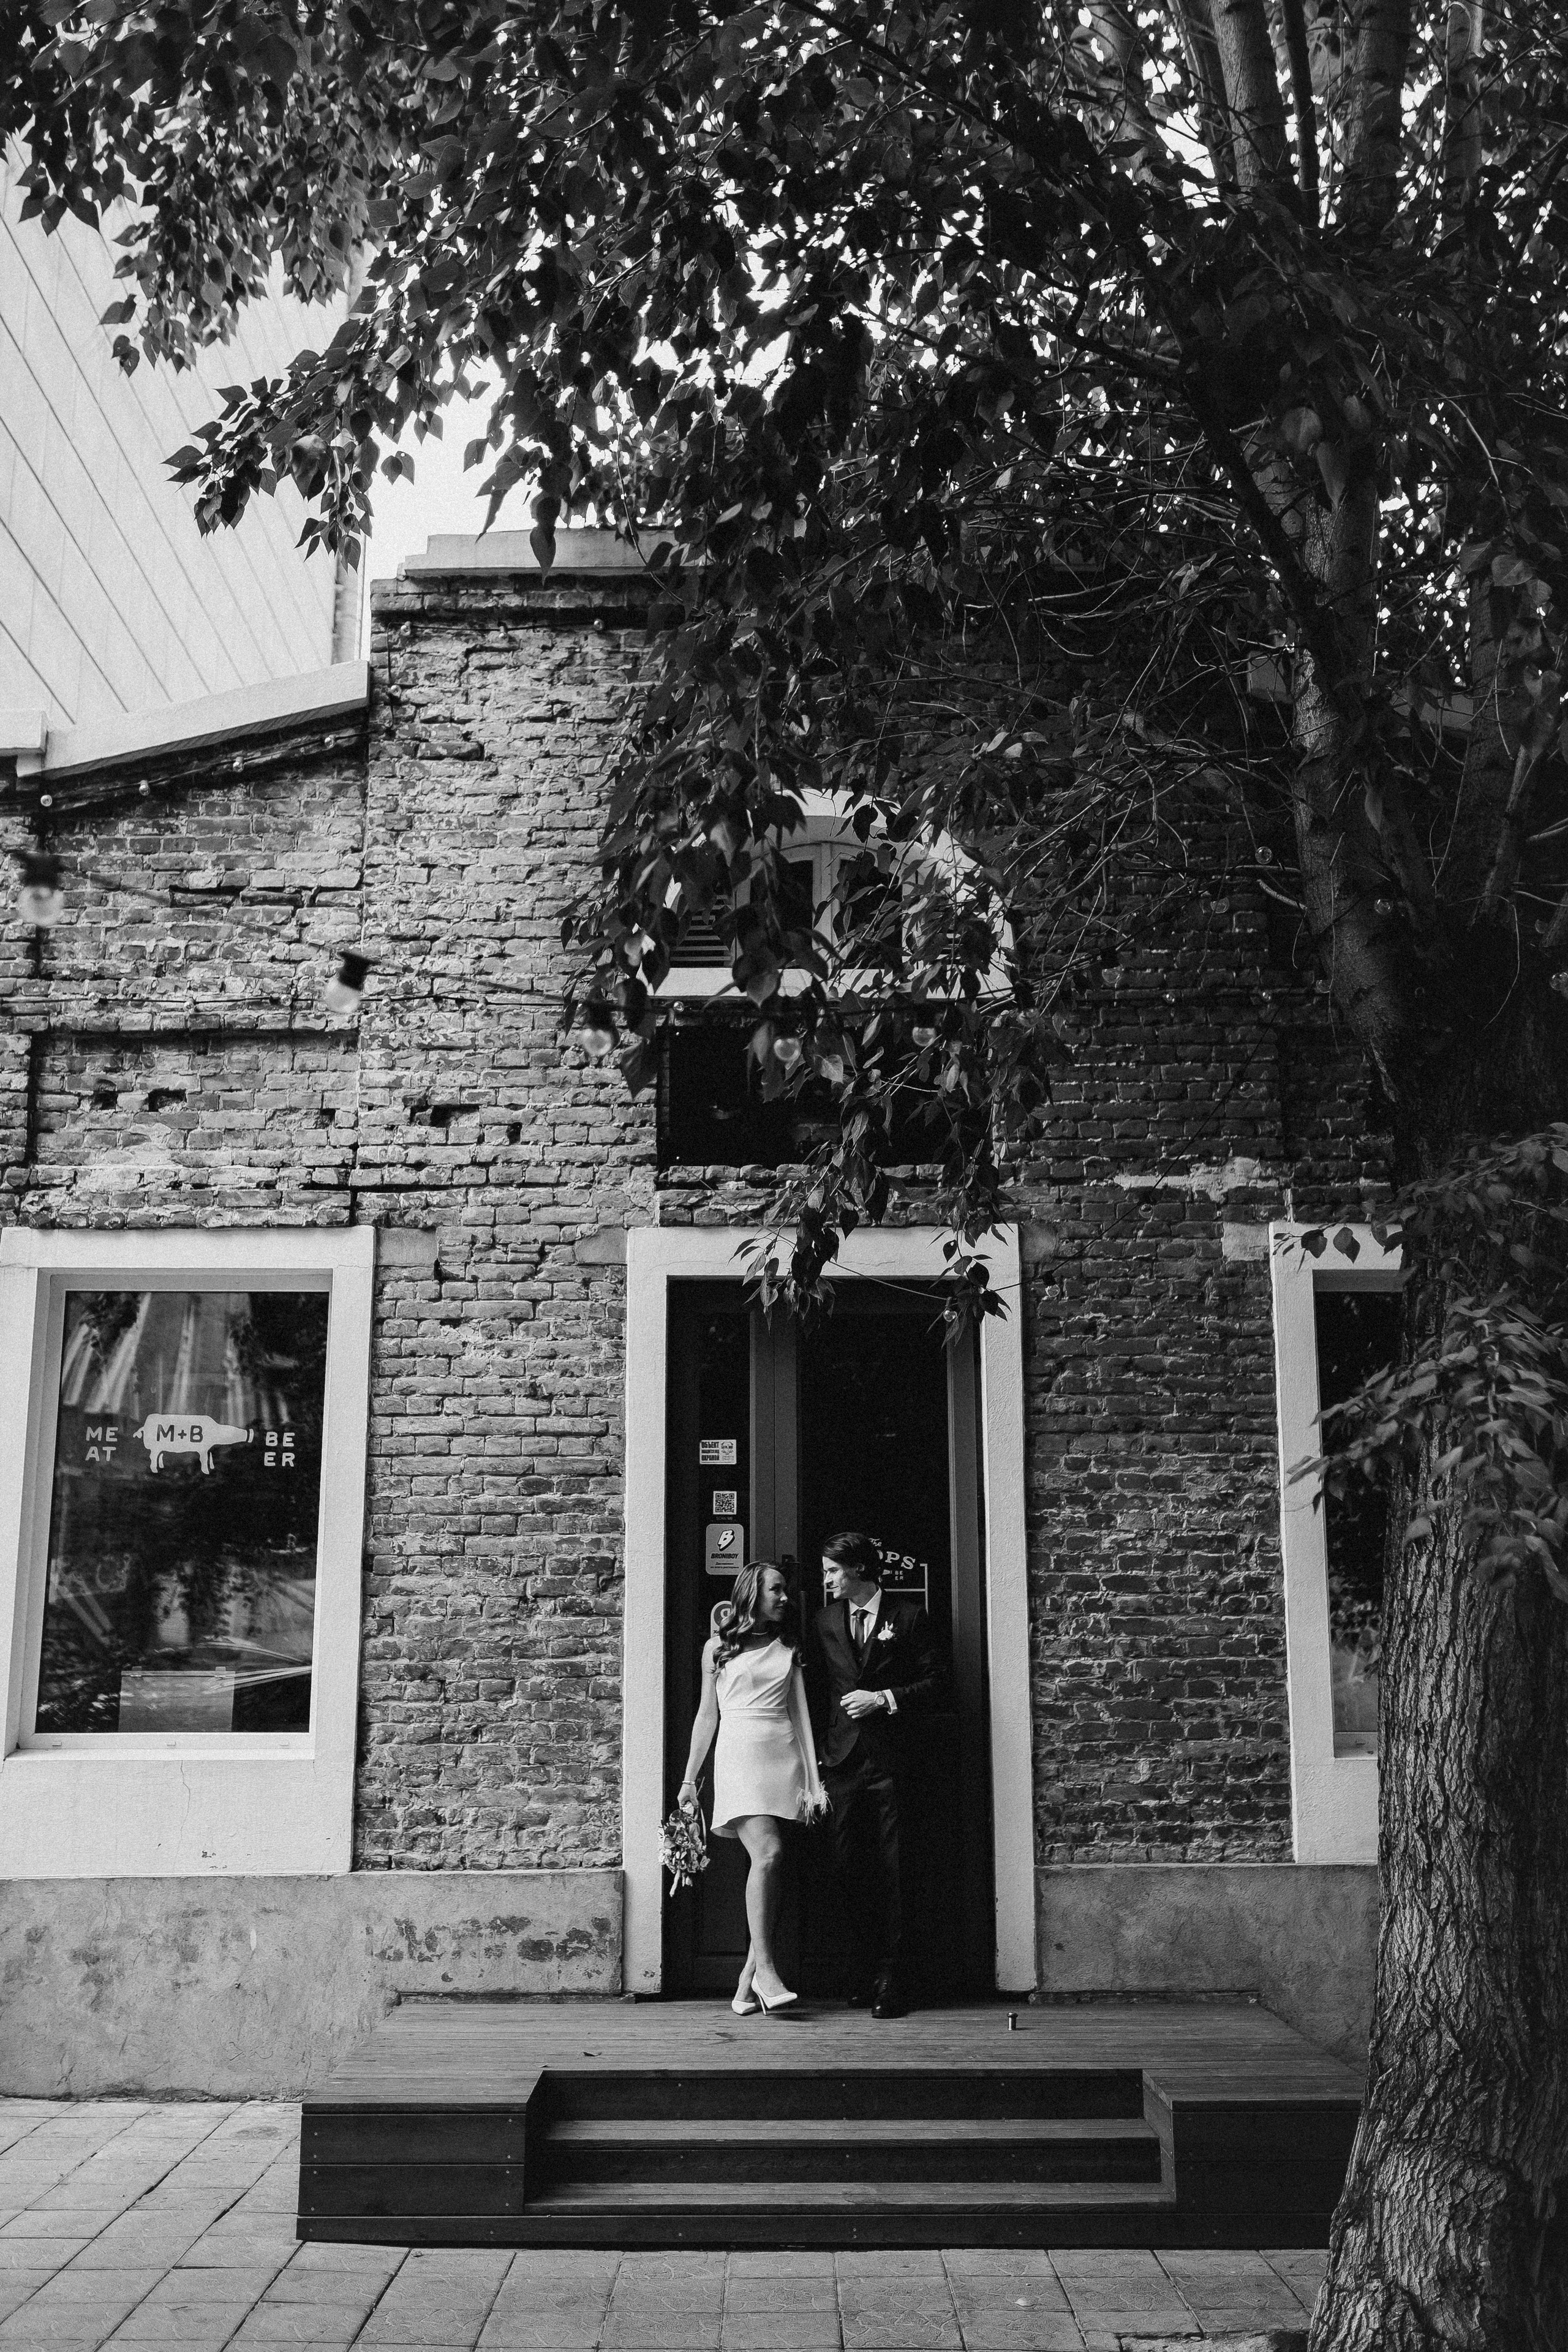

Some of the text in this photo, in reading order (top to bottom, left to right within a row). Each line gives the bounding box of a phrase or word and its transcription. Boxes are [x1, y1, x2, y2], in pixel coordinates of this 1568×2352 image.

[85, 1426, 119, 1442] ME
[156, 1424, 204, 1443] M+B
[265, 1431, 295, 1447] BE
[85, 1446, 117, 1462] AT
[264, 1452, 295, 1467] ER
[869, 1537, 882, 1547] The
